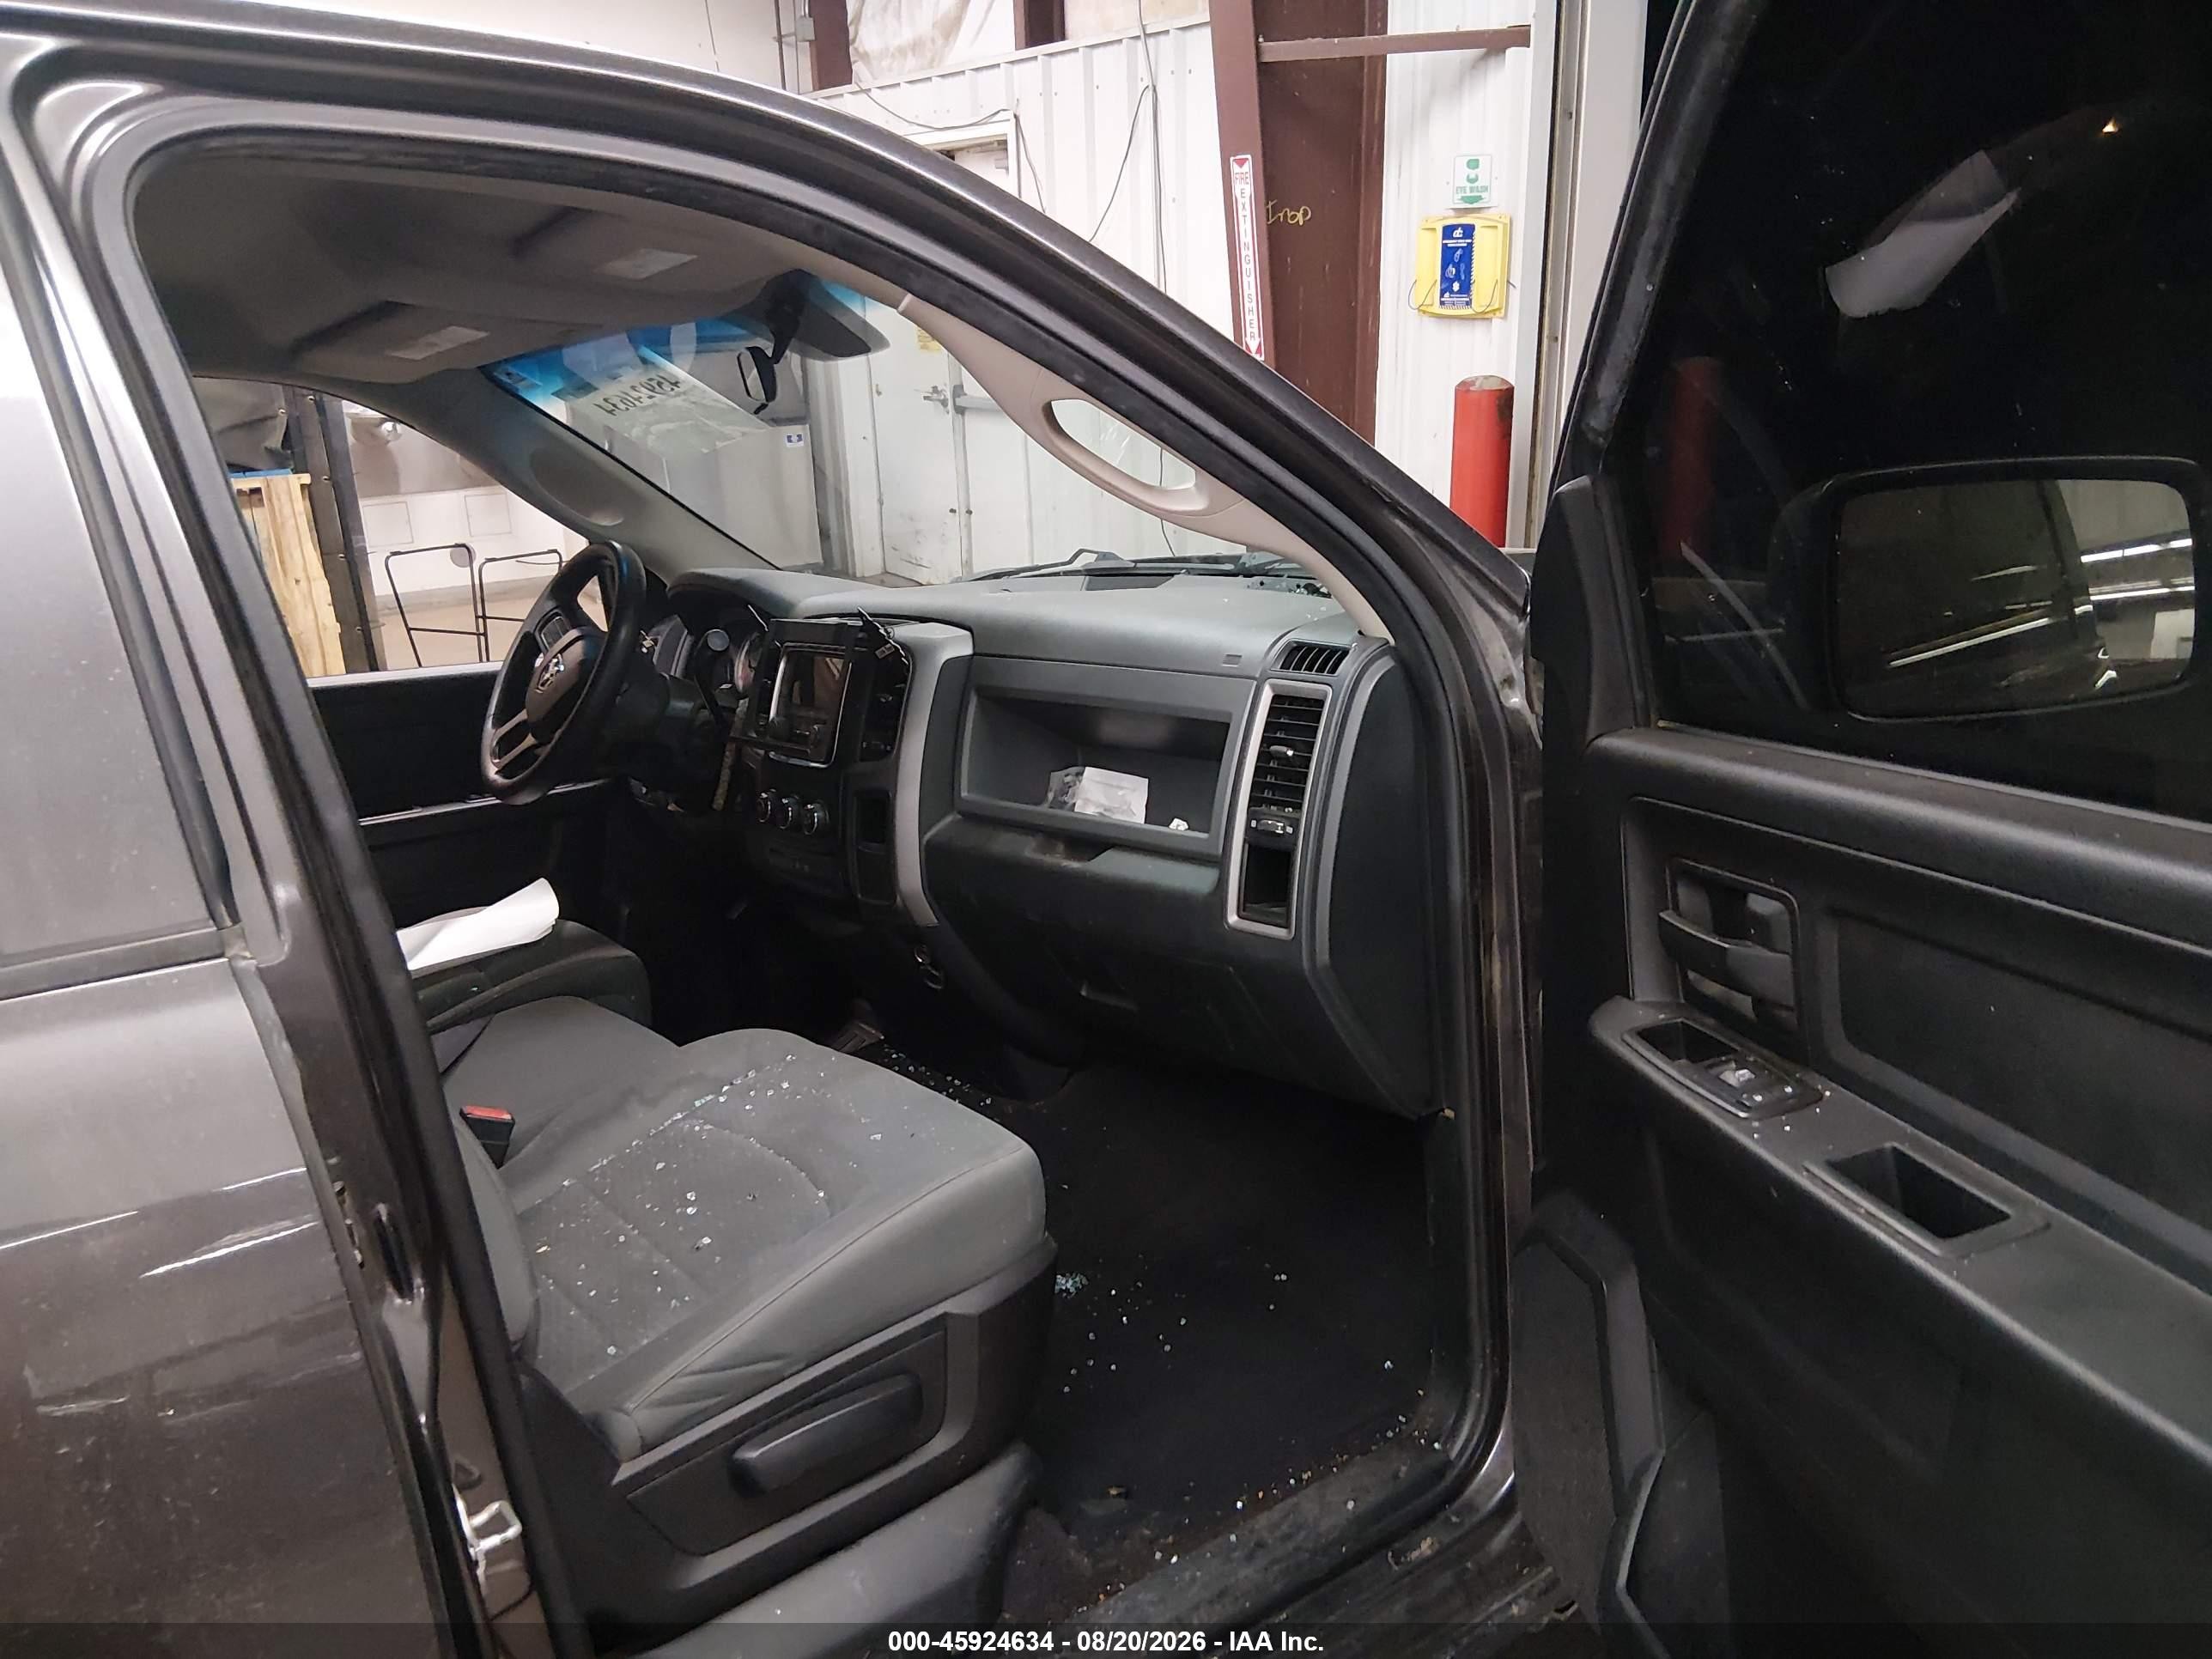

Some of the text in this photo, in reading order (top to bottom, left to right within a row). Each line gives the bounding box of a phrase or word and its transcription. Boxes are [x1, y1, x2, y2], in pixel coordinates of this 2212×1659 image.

[1235, 171, 1249, 185] FIRE
[1455, 185, 1489, 194] EYE WASH
[1240, 187, 1257, 342] EXTINGUISHER
